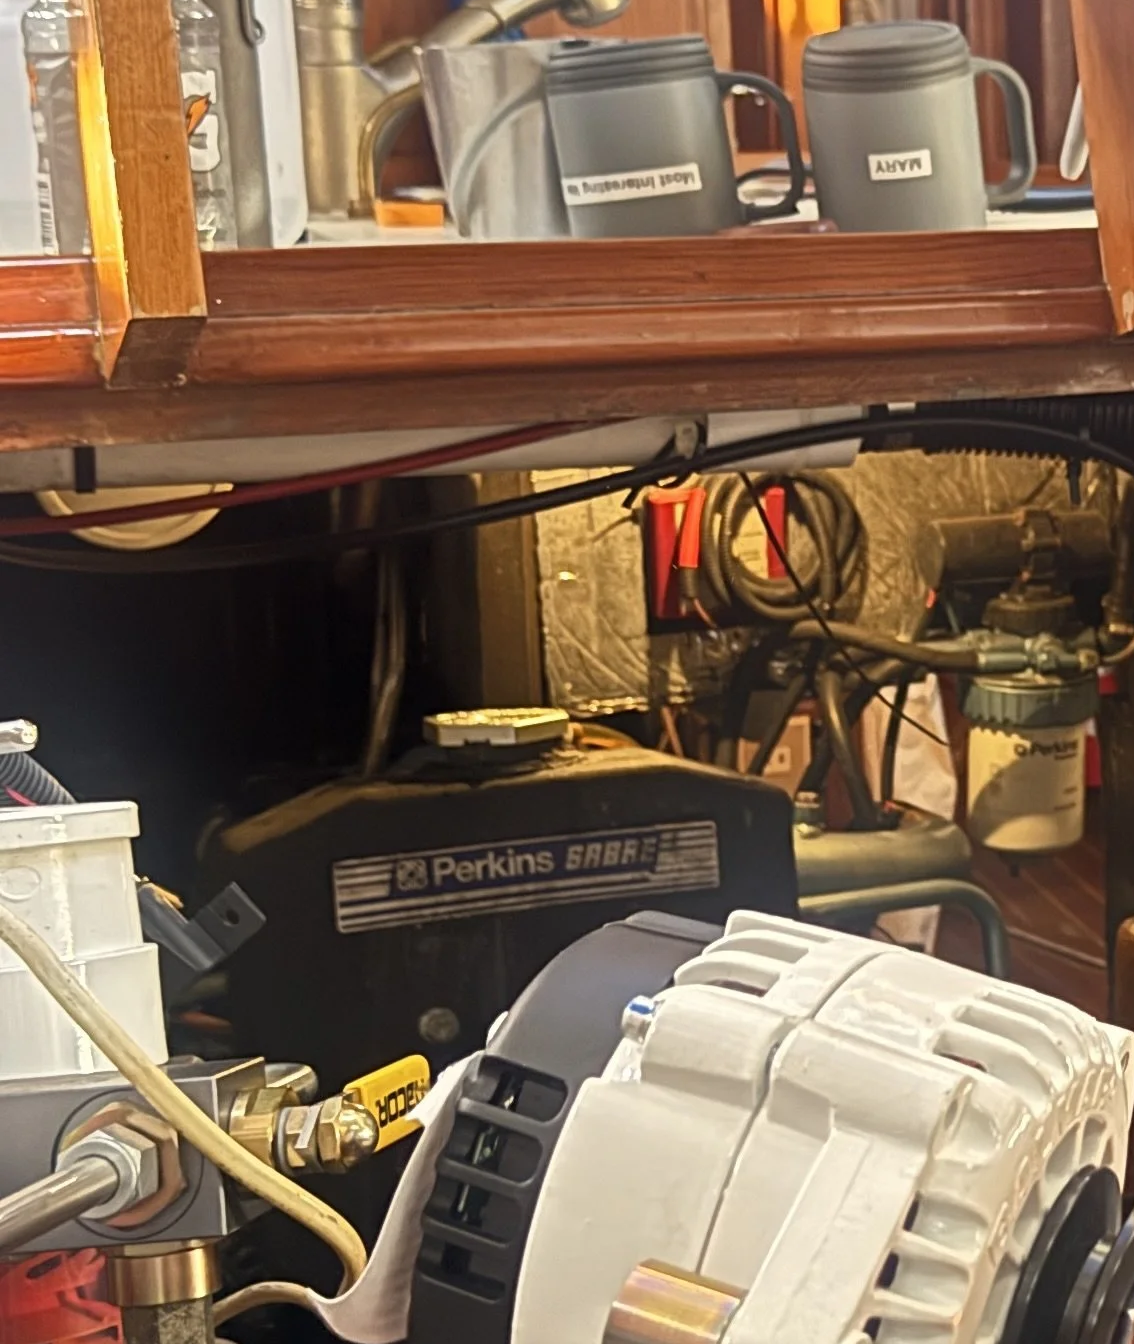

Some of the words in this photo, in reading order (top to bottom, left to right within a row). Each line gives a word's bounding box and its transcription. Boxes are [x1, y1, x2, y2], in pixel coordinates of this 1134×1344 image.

[876, 157, 922, 173] MARY
[582, 176, 656, 195] Interesting
[659, 171, 695, 188] Most
[432, 848, 555, 887] Perkins
